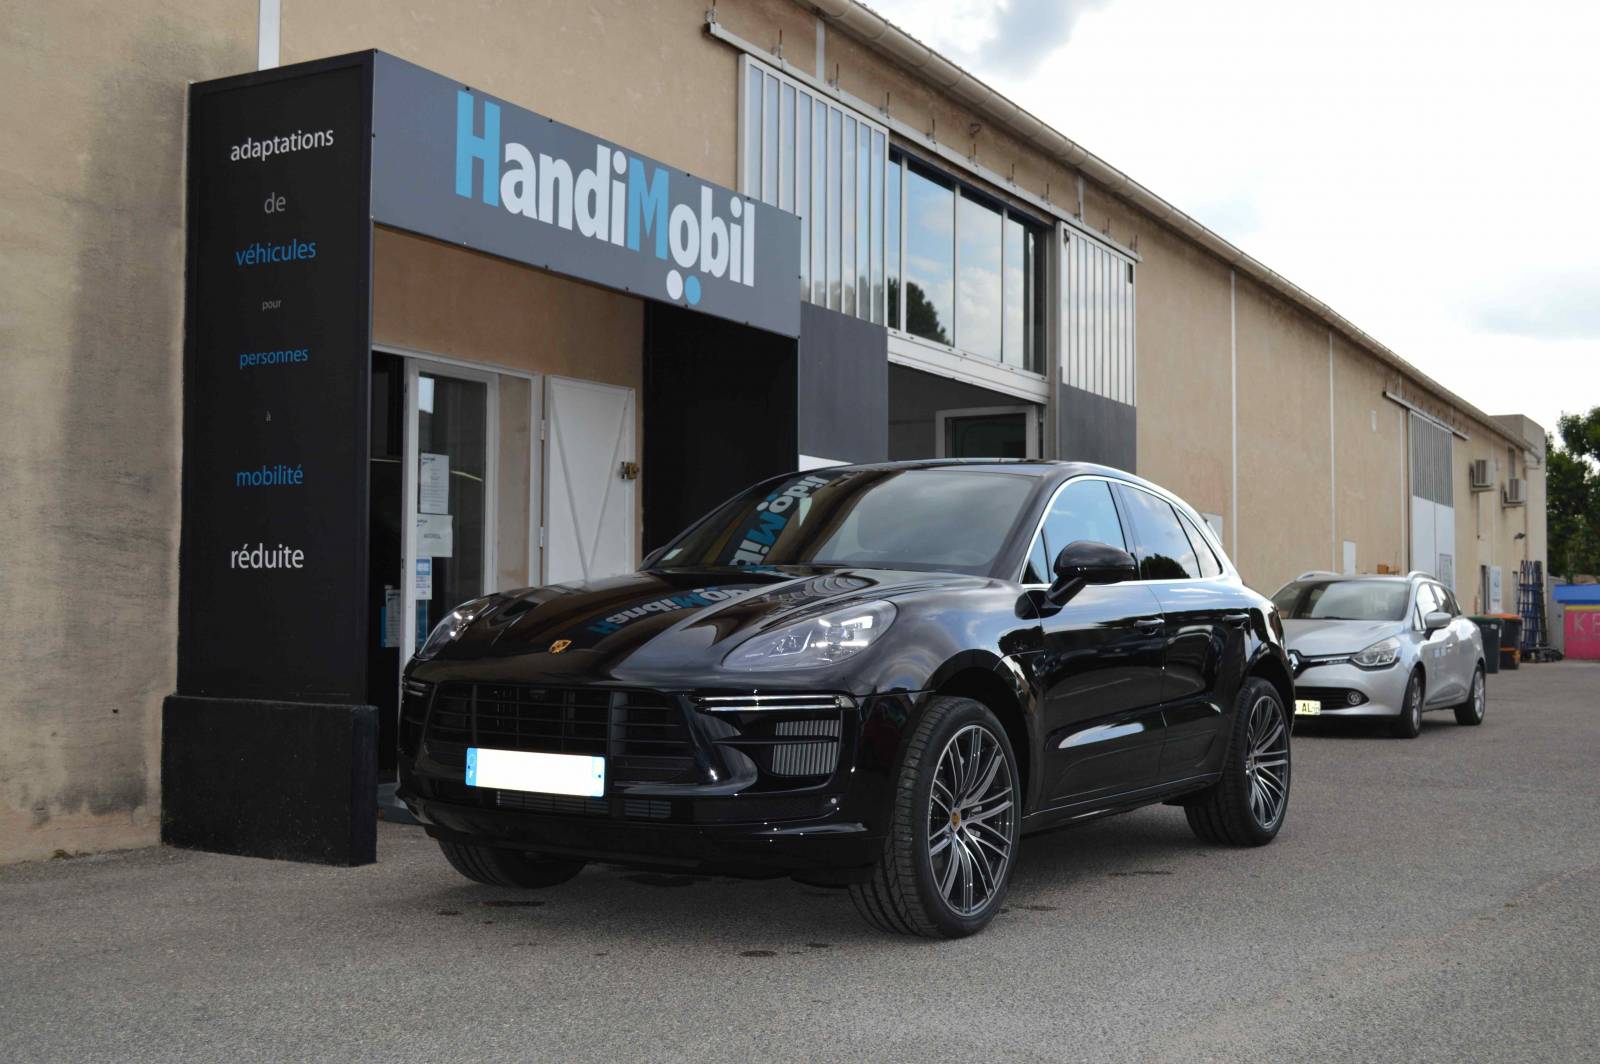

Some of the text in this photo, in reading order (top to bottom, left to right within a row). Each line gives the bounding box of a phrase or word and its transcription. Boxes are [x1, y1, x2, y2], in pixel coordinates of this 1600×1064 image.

[231, 130, 333, 161] adaptations
[455, 89, 755, 287] HandiMobil
[264, 192, 286, 213] de
[236, 239, 316, 265] véhicules
[262, 300, 281, 311] pour
[240, 349, 308, 368] personnes
[237, 464, 303, 486] mobilité
[232, 543, 304, 568] réduite
